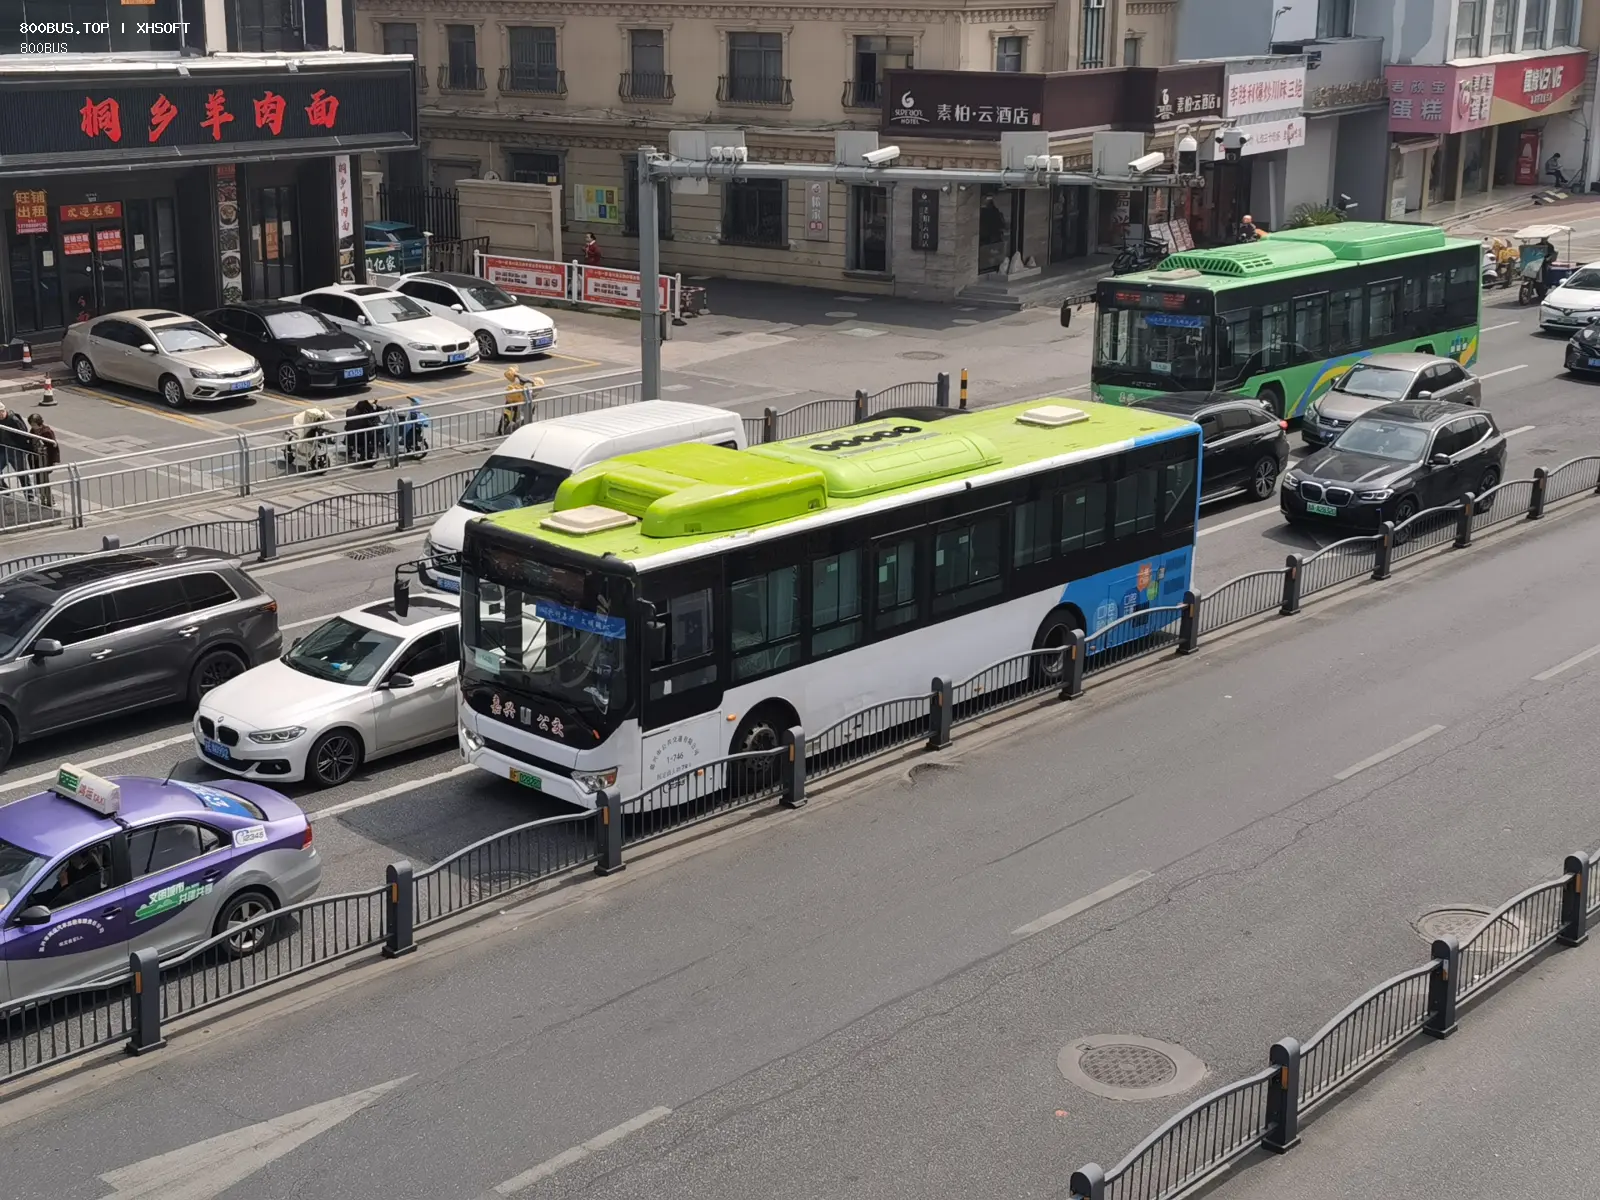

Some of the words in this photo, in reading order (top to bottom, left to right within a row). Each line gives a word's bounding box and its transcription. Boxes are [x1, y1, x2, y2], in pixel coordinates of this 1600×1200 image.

[80, 89, 339, 141] 桐乡羊肉面
[937, 103, 1029, 125] 素柏·云酒店
[1391, 98, 1443, 120] 蛋糕
